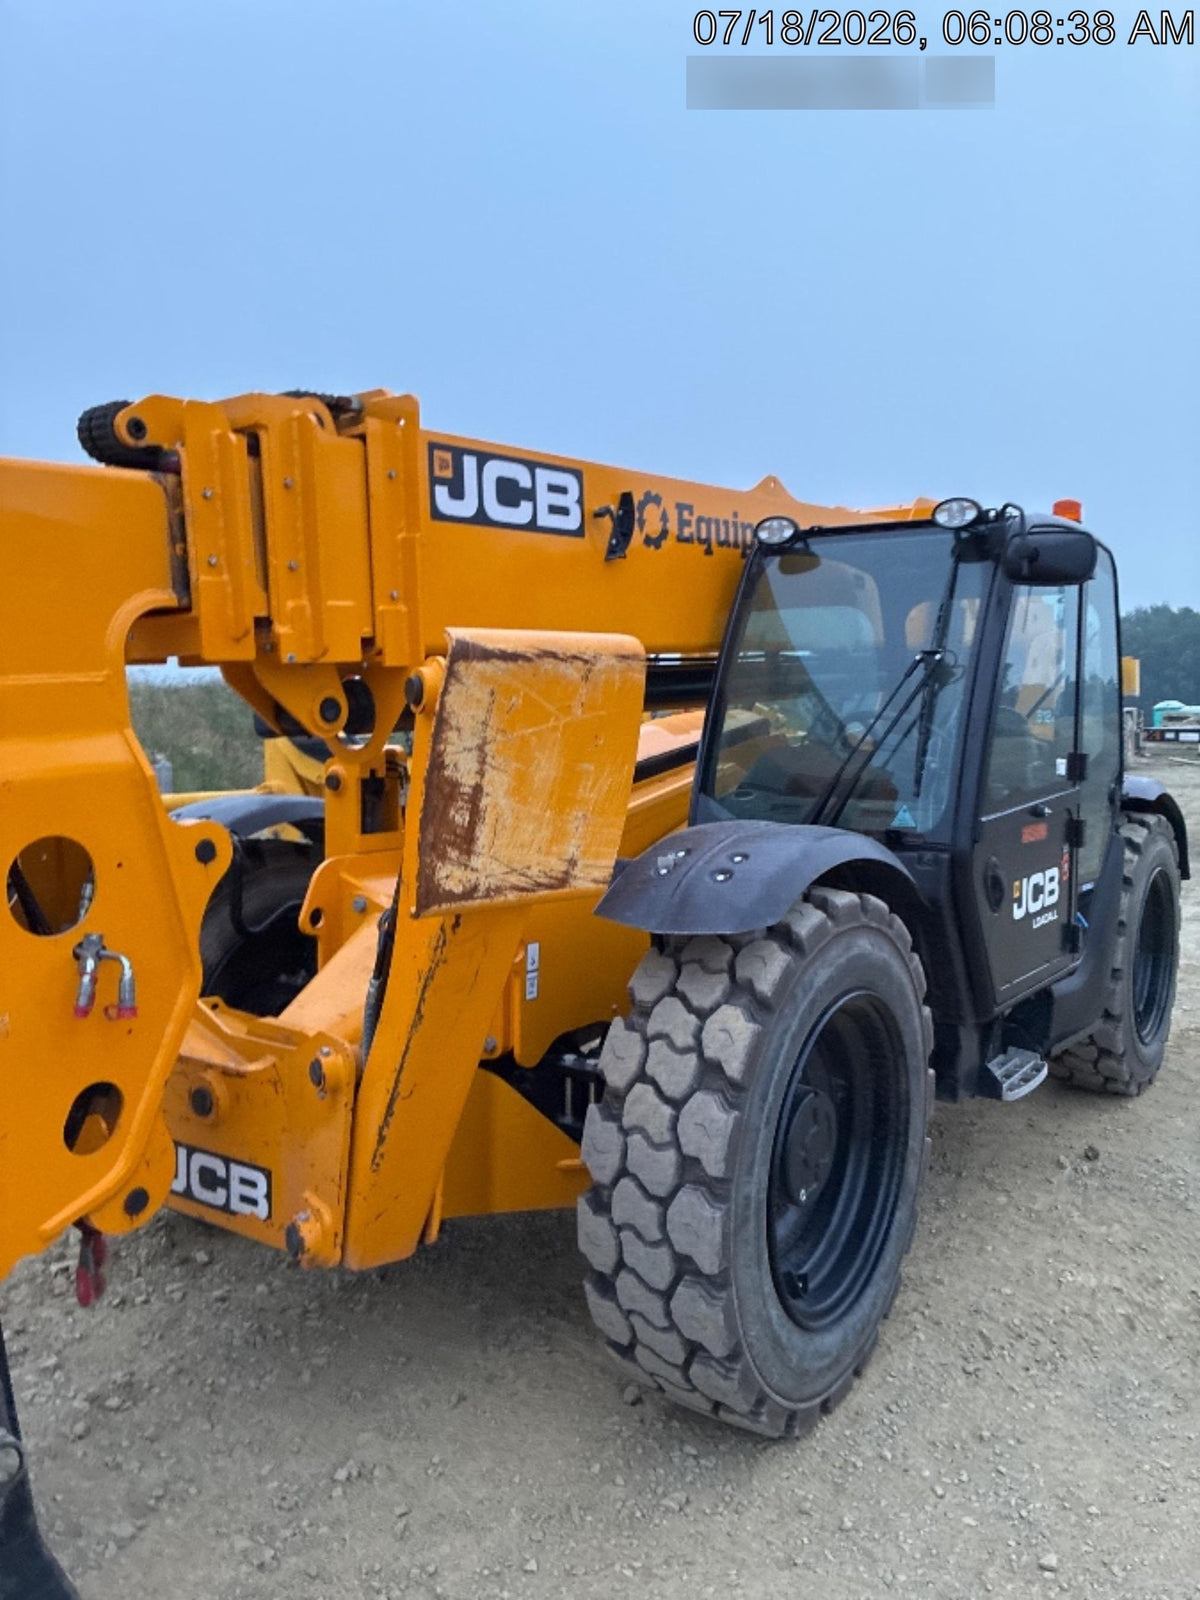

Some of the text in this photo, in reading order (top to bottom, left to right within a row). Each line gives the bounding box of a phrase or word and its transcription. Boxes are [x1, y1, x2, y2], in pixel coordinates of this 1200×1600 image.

[434, 454, 583, 532] JCB
[1013, 867, 1060, 920] JCB
[171, 1146, 269, 1221] JCB
